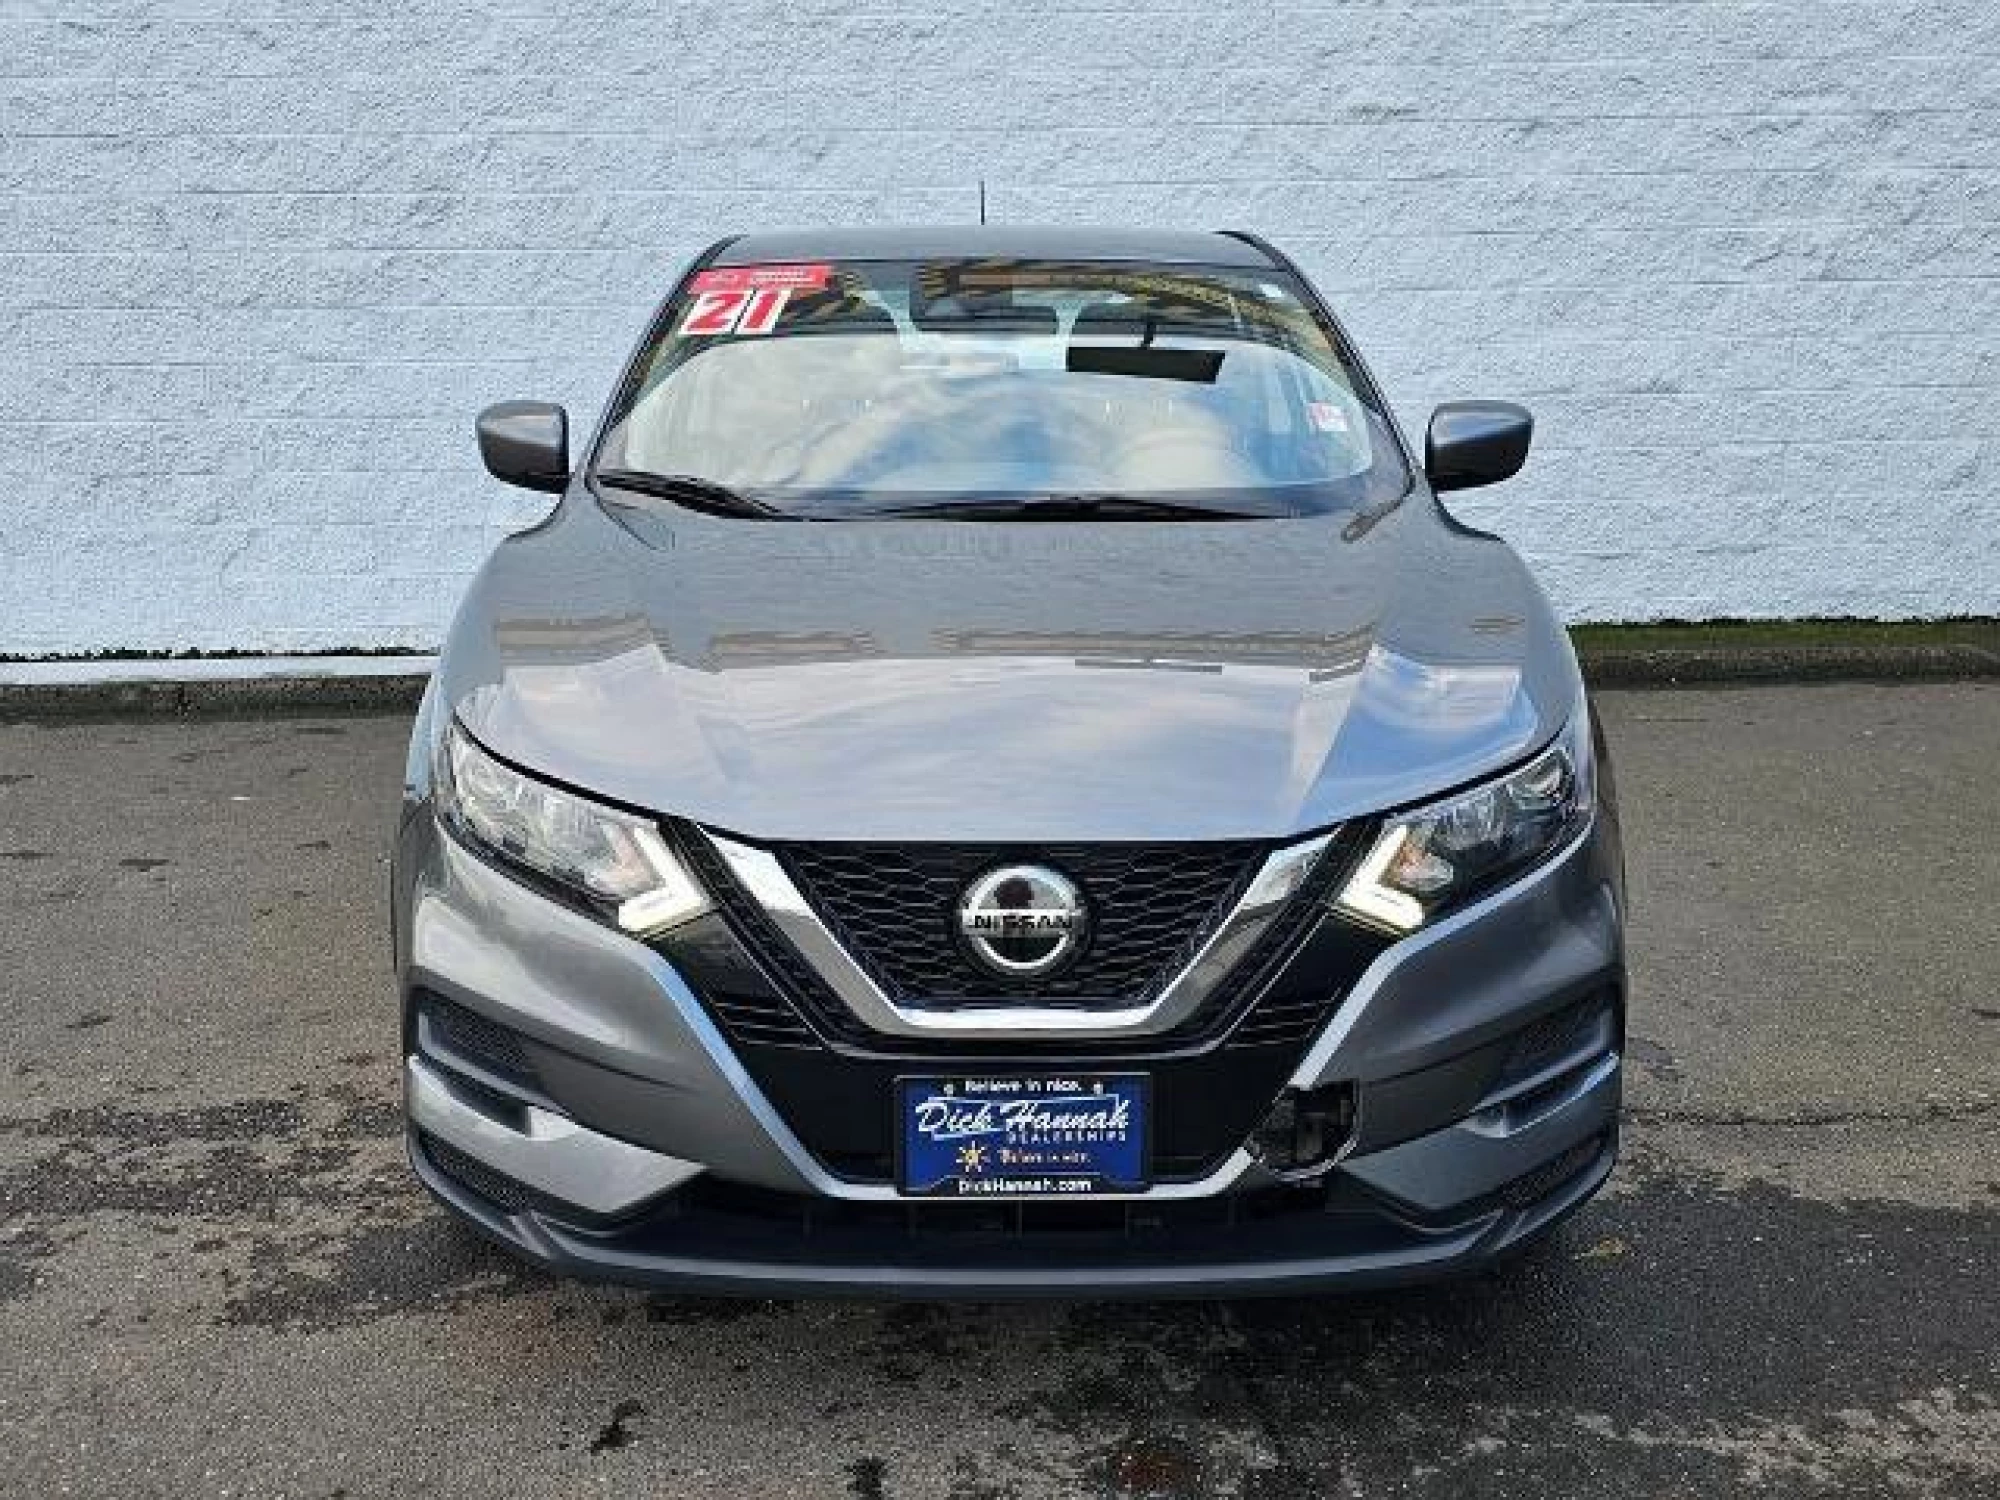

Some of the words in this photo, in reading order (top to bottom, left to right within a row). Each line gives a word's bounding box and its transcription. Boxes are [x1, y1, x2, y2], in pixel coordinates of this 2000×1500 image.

[679, 289, 791, 335] 21
[973, 914, 1073, 930] NISSAN
[915, 1101, 994, 1132] Dick
[1000, 1099, 1131, 1132] Hannah
[958, 1178, 1092, 1193] DickHannah.com
